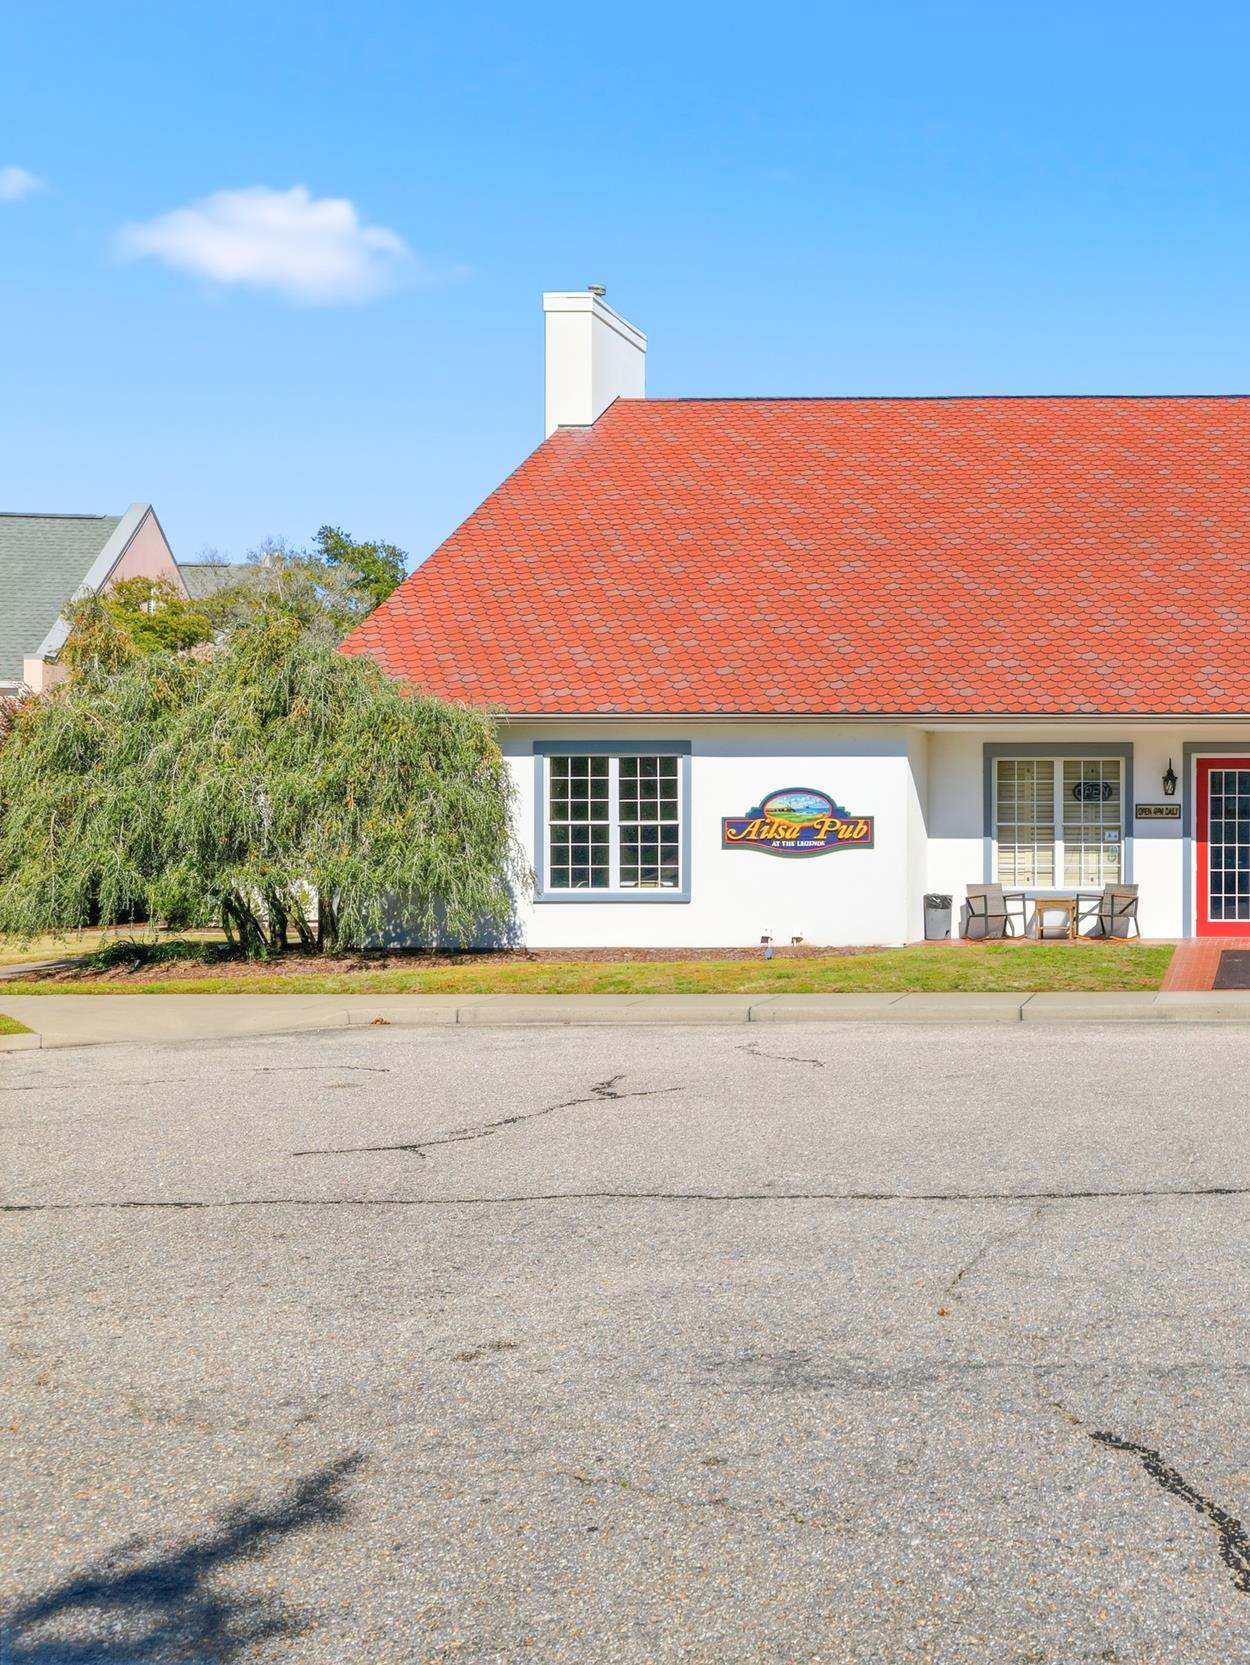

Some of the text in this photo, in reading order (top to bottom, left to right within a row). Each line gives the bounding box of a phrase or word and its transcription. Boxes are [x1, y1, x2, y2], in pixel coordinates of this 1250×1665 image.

[1074, 784, 1110, 799] OPEN
[1138, 807, 1152, 816] OPEN
[727, 818, 868, 840] Ailsa Pub
